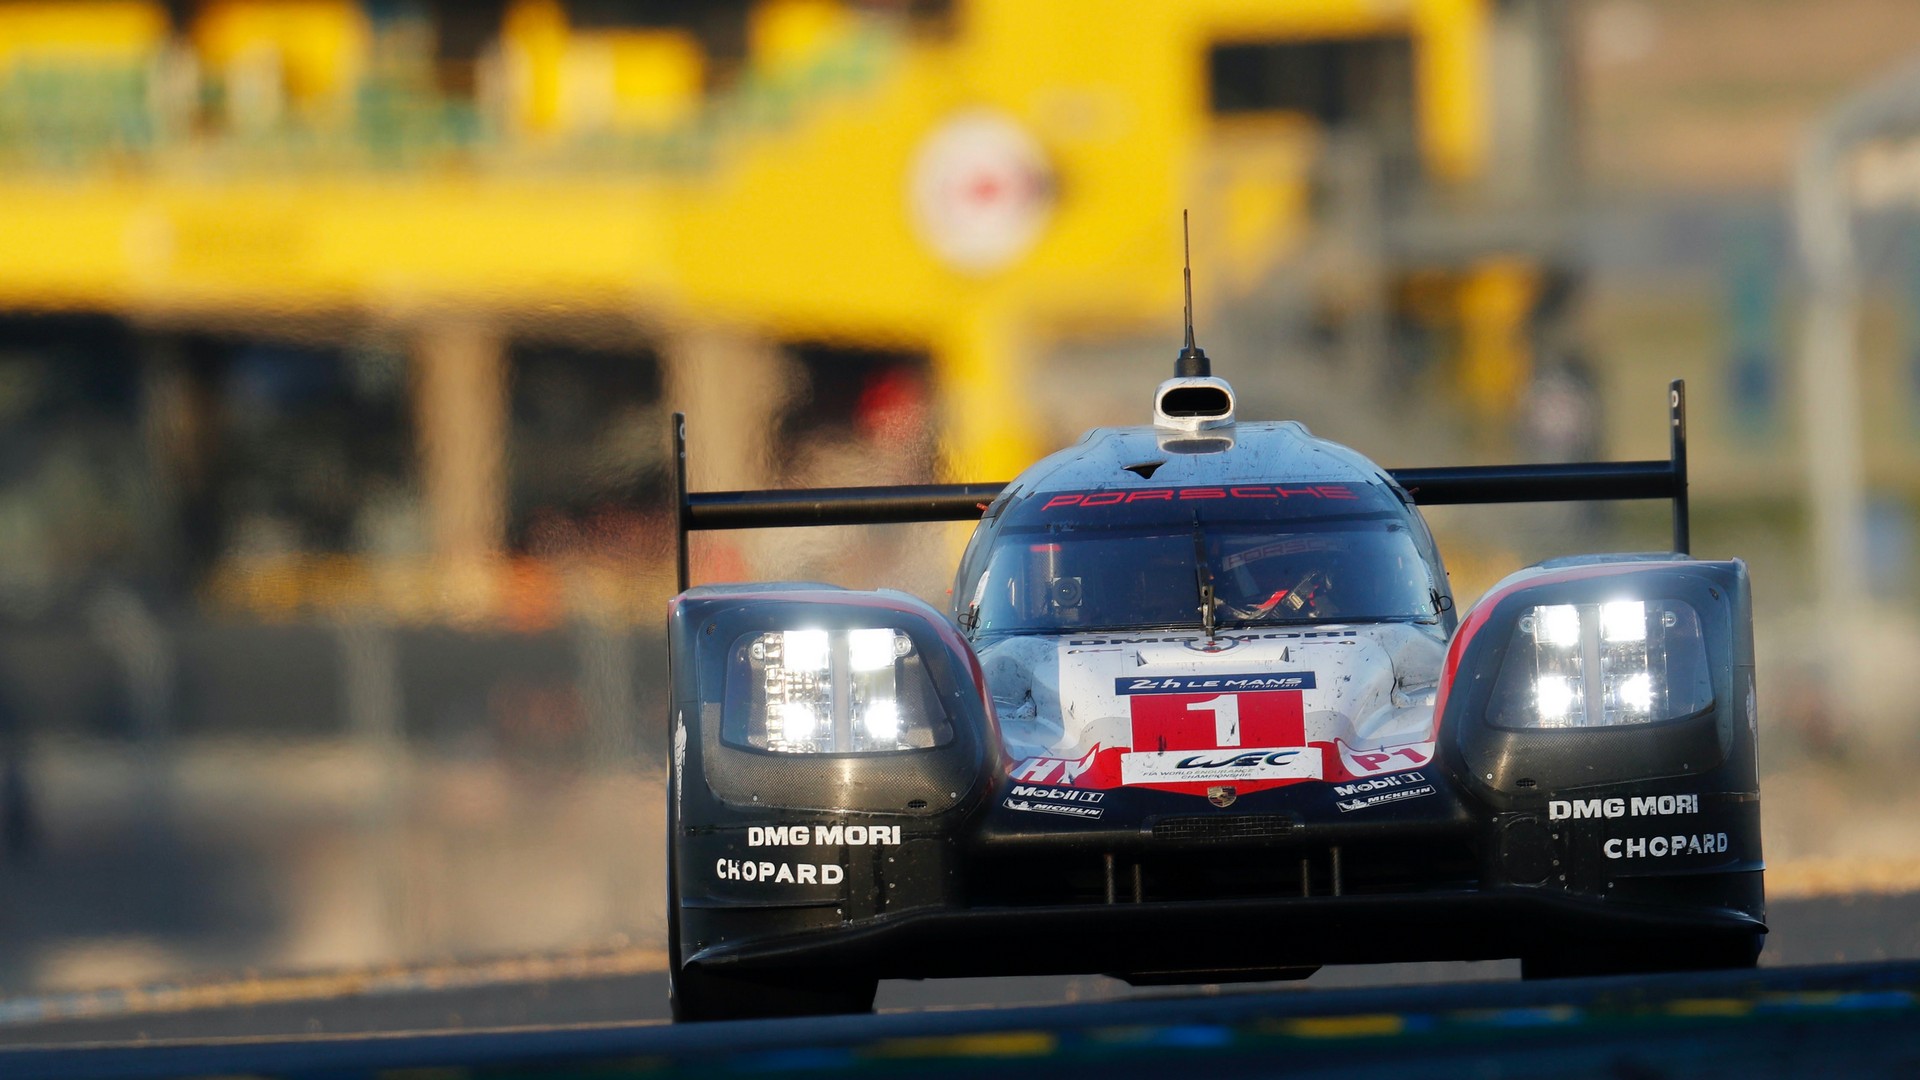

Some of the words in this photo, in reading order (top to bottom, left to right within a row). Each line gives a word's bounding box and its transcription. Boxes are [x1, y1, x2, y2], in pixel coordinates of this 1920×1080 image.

[1041, 486, 1359, 511] PORSCHE
[1069, 635, 1199, 647] DMG
[1217, 630, 1357, 642] MORI
[1187, 680, 1221, 688] LE
[1225, 677, 1302, 687] MANS
[1187, 694, 1241, 748] 1
[1175, 751, 1300, 769] WEC
[1351, 748, 1427, 772] P1
[1011, 785, 1080, 800] Mobil
[1333, 776, 1402, 796] Mobil
[1033, 803, 1101, 815] MICHELIN
[1549, 798, 1625, 820] DMG
[1630, 794, 1698, 815] MORI
[748, 826, 809, 847] DMG
[815, 825, 900, 846] MORI
[1603, 832, 1728, 859] CHOPARD
[716, 858, 844, 885] CHOPARD
